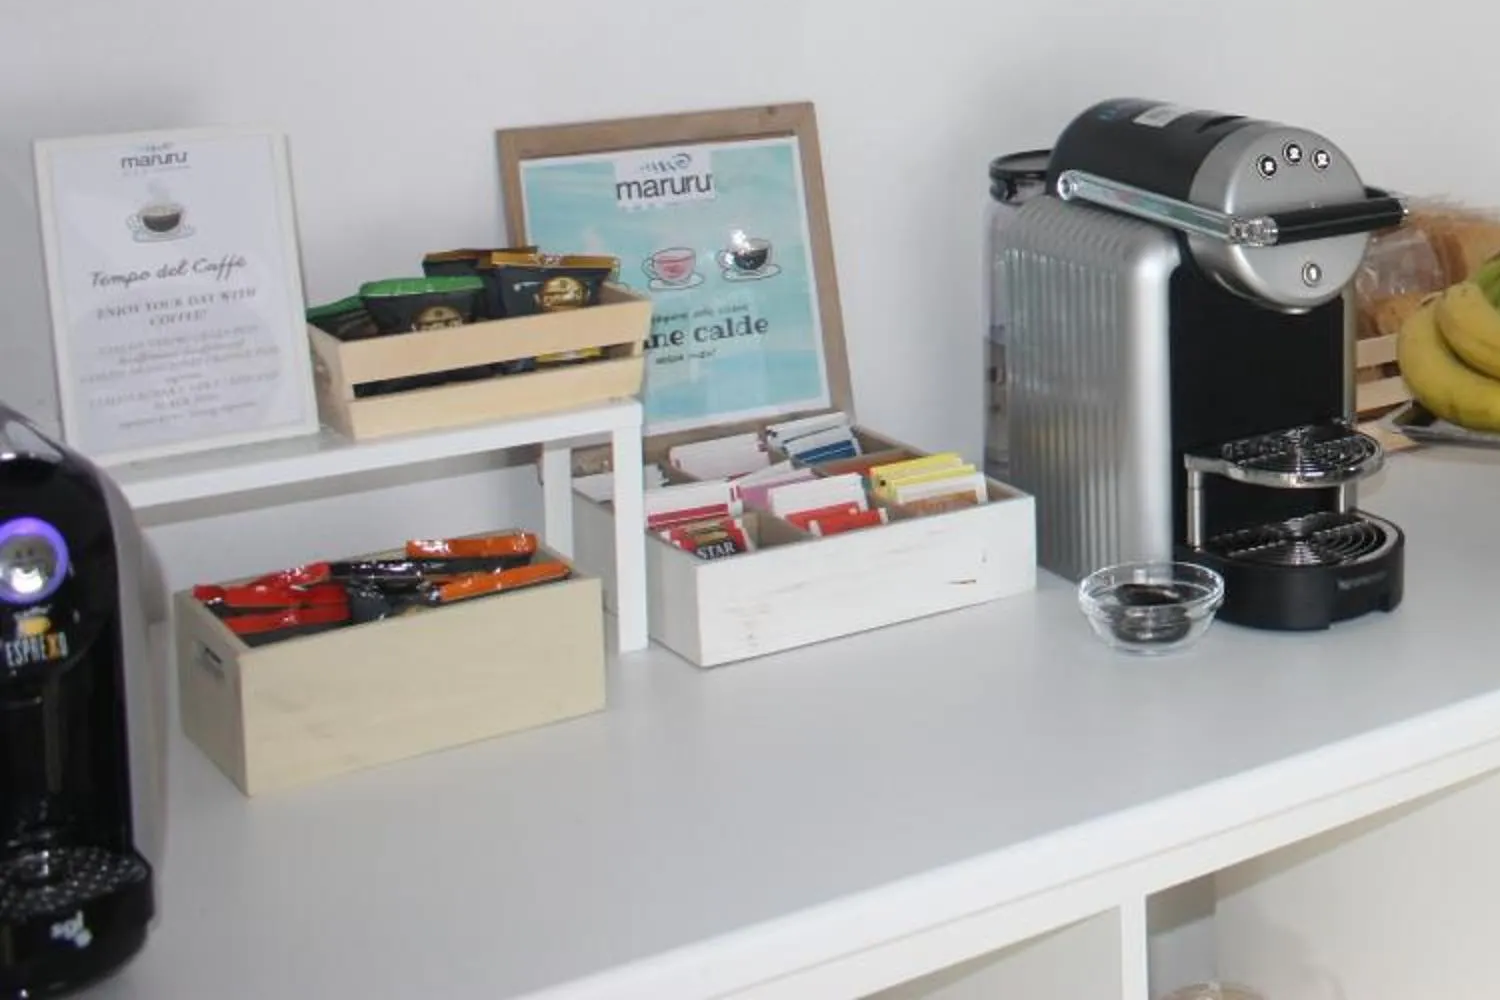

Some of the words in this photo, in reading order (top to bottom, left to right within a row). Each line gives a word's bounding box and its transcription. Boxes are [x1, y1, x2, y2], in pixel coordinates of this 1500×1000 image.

[121, 151, 188, 169] maruru
[615, 172, 713, 201] maruru
[90, 268, 151, 288] Tempo
[156, 258, 189, 279] del
[693, 315, 769, 343] calde
